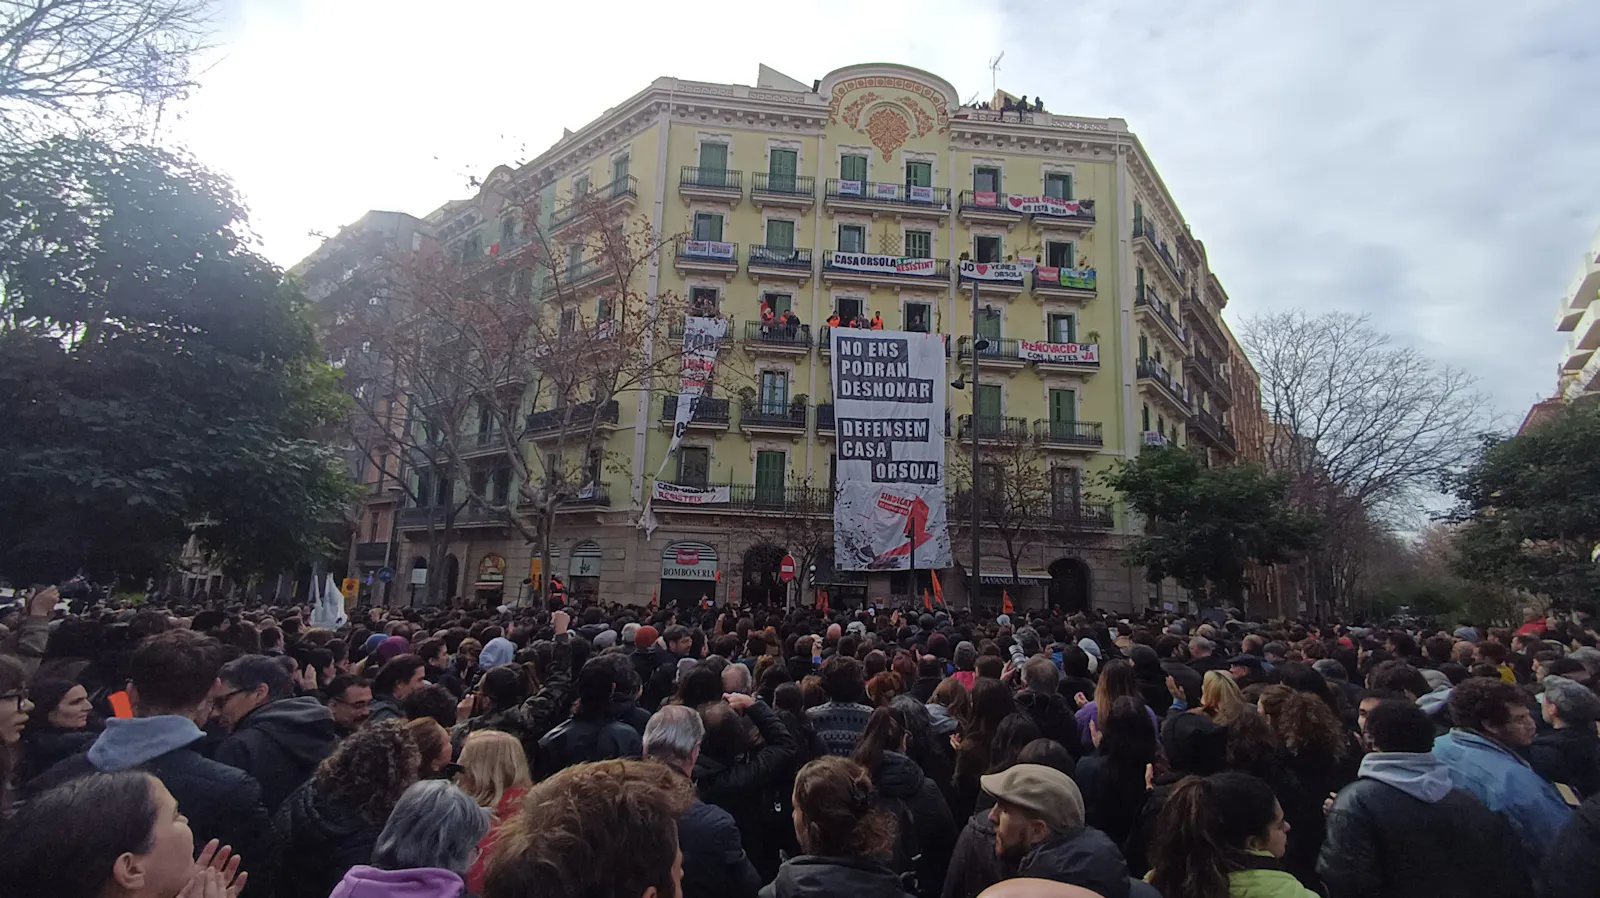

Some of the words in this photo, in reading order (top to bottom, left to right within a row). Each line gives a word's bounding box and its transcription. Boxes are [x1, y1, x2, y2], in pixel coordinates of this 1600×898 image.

[896, 260, 934, 272] RESISTINT
[961, 263, 974, 272] JO
[841, 340, 862, 356] NO
[868, 341, 899, 358] ENS
[1081, 352, 1095, 361] JA
[841, 360, 908, 378] PODRAN
[841, 380, 930, 398] DESNONAR
[842, 420, 927, 437] DEFENSEM
[842, 440, 887, 458] CASA
[875, 462, 937, 480] ORSOLA
[663, 567, 716, 578] BOMBONERIA
